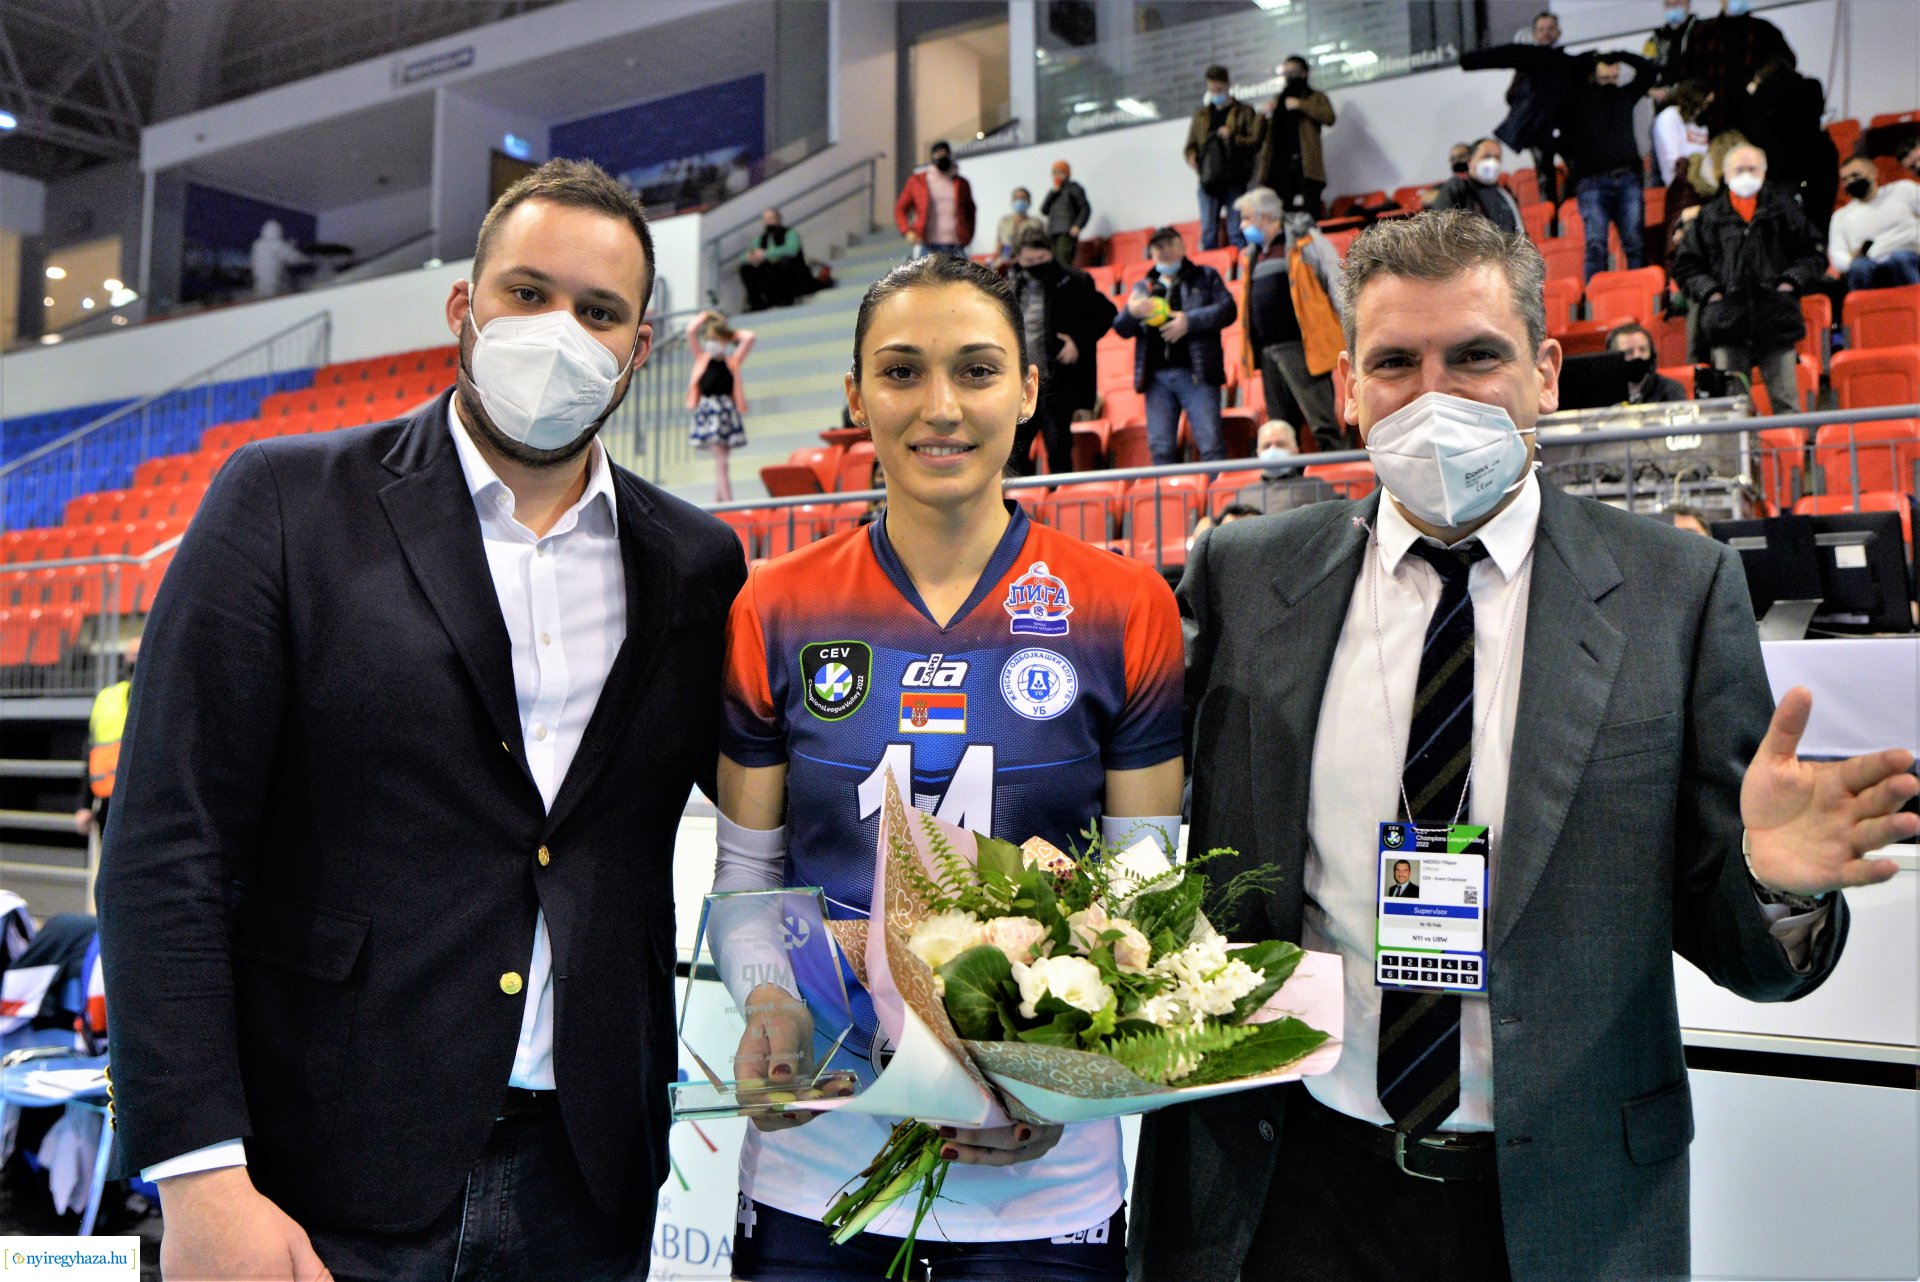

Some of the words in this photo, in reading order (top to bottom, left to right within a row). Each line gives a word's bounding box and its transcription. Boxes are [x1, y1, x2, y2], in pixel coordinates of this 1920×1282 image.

[1009, 584, 1067, 605] ЛИГА
[819, 647, 850, 659] CEV
[1061, 664, 1074, 684] КЛУБ
[1033, 706, 1046, 715] УБ
[857, 743, 994, 839] 14
[1416, 835, 1447, 843] Champions
[1413, 906, 1448, 915] Supervisor
[1389, 957, 1393, 965] 1
[1407, 958, 1413, 966] 2
[1446, 961, 1453, 969] 4
[1467, 962, 1472, 970] 5
[1387, 970, 1393, 978] 6
[1426, 973, 1432, 981] 8
[1446, 974, 1452, 982] 9
[1465, 975, 1474, 984] 10
[651, 1222, 733, 1268] BDA
